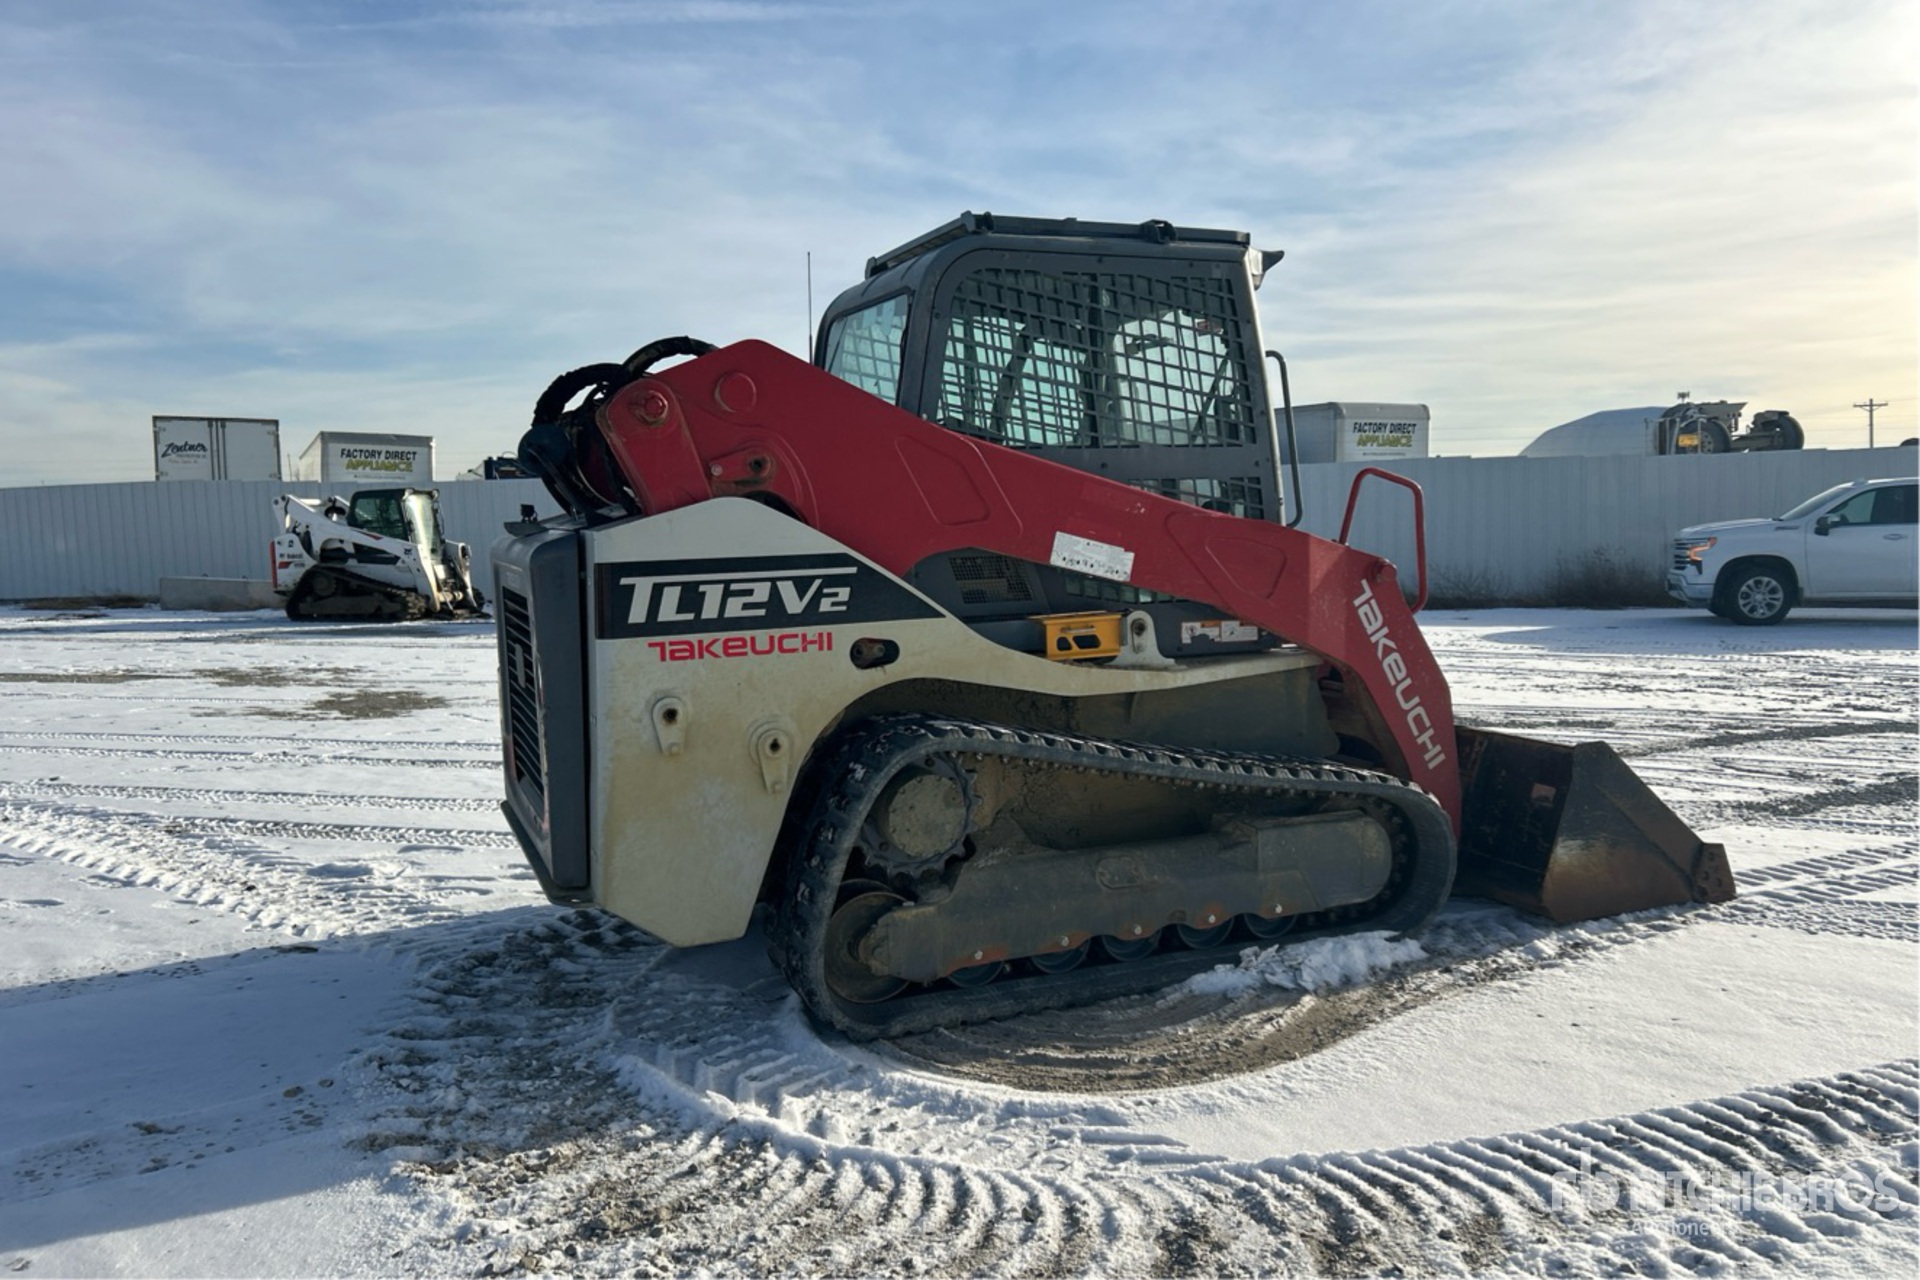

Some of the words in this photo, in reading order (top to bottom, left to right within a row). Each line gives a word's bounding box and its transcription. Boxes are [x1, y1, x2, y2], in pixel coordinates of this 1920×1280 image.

[1353, 422, 1387, 434] FACTORY
[1389, 423, 1417, 435] DIRECT
[1356, 434, 1412, 447] APPLIANCE
[340, 448, 382, 459] FACTORY
[385, 450, 417, 461] DIRECT
[345, 459, 413, 472] APPLIANCE
